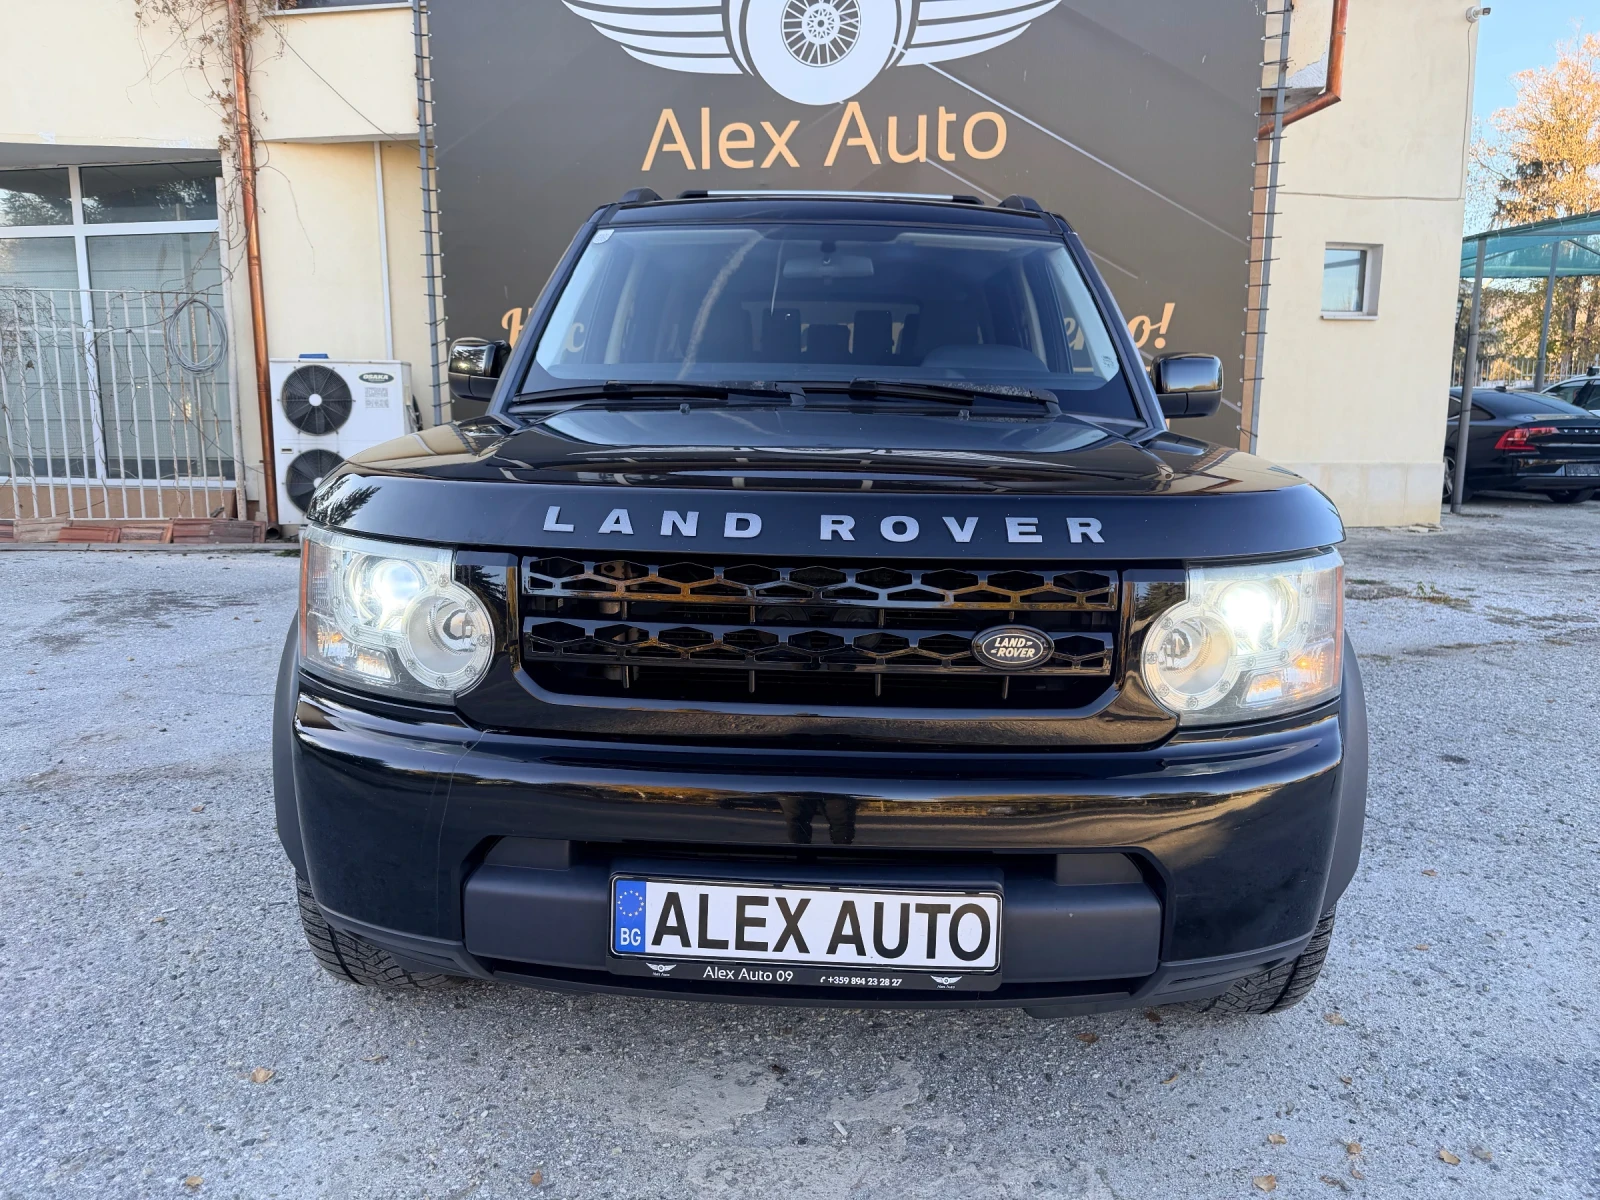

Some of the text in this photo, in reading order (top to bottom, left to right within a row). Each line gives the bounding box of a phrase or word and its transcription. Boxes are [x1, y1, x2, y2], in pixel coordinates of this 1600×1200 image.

[641, 101, 1008, 171] Alex Auto
[543, 506, 1105, 543] LAND ROVER
[994, 637, 1026, 647] LAND
[996, 647, 1036, 657] ROVER
[651, 891, 991, 961] ALEX AUTO
[620, 927, 642, 947] BG
[703, 966, 794, 982] Alex Auto 09
[828, 976, 849, 984] +359
[851, 977, 866, 985] 894
[879, 978, 890, 986] 28
